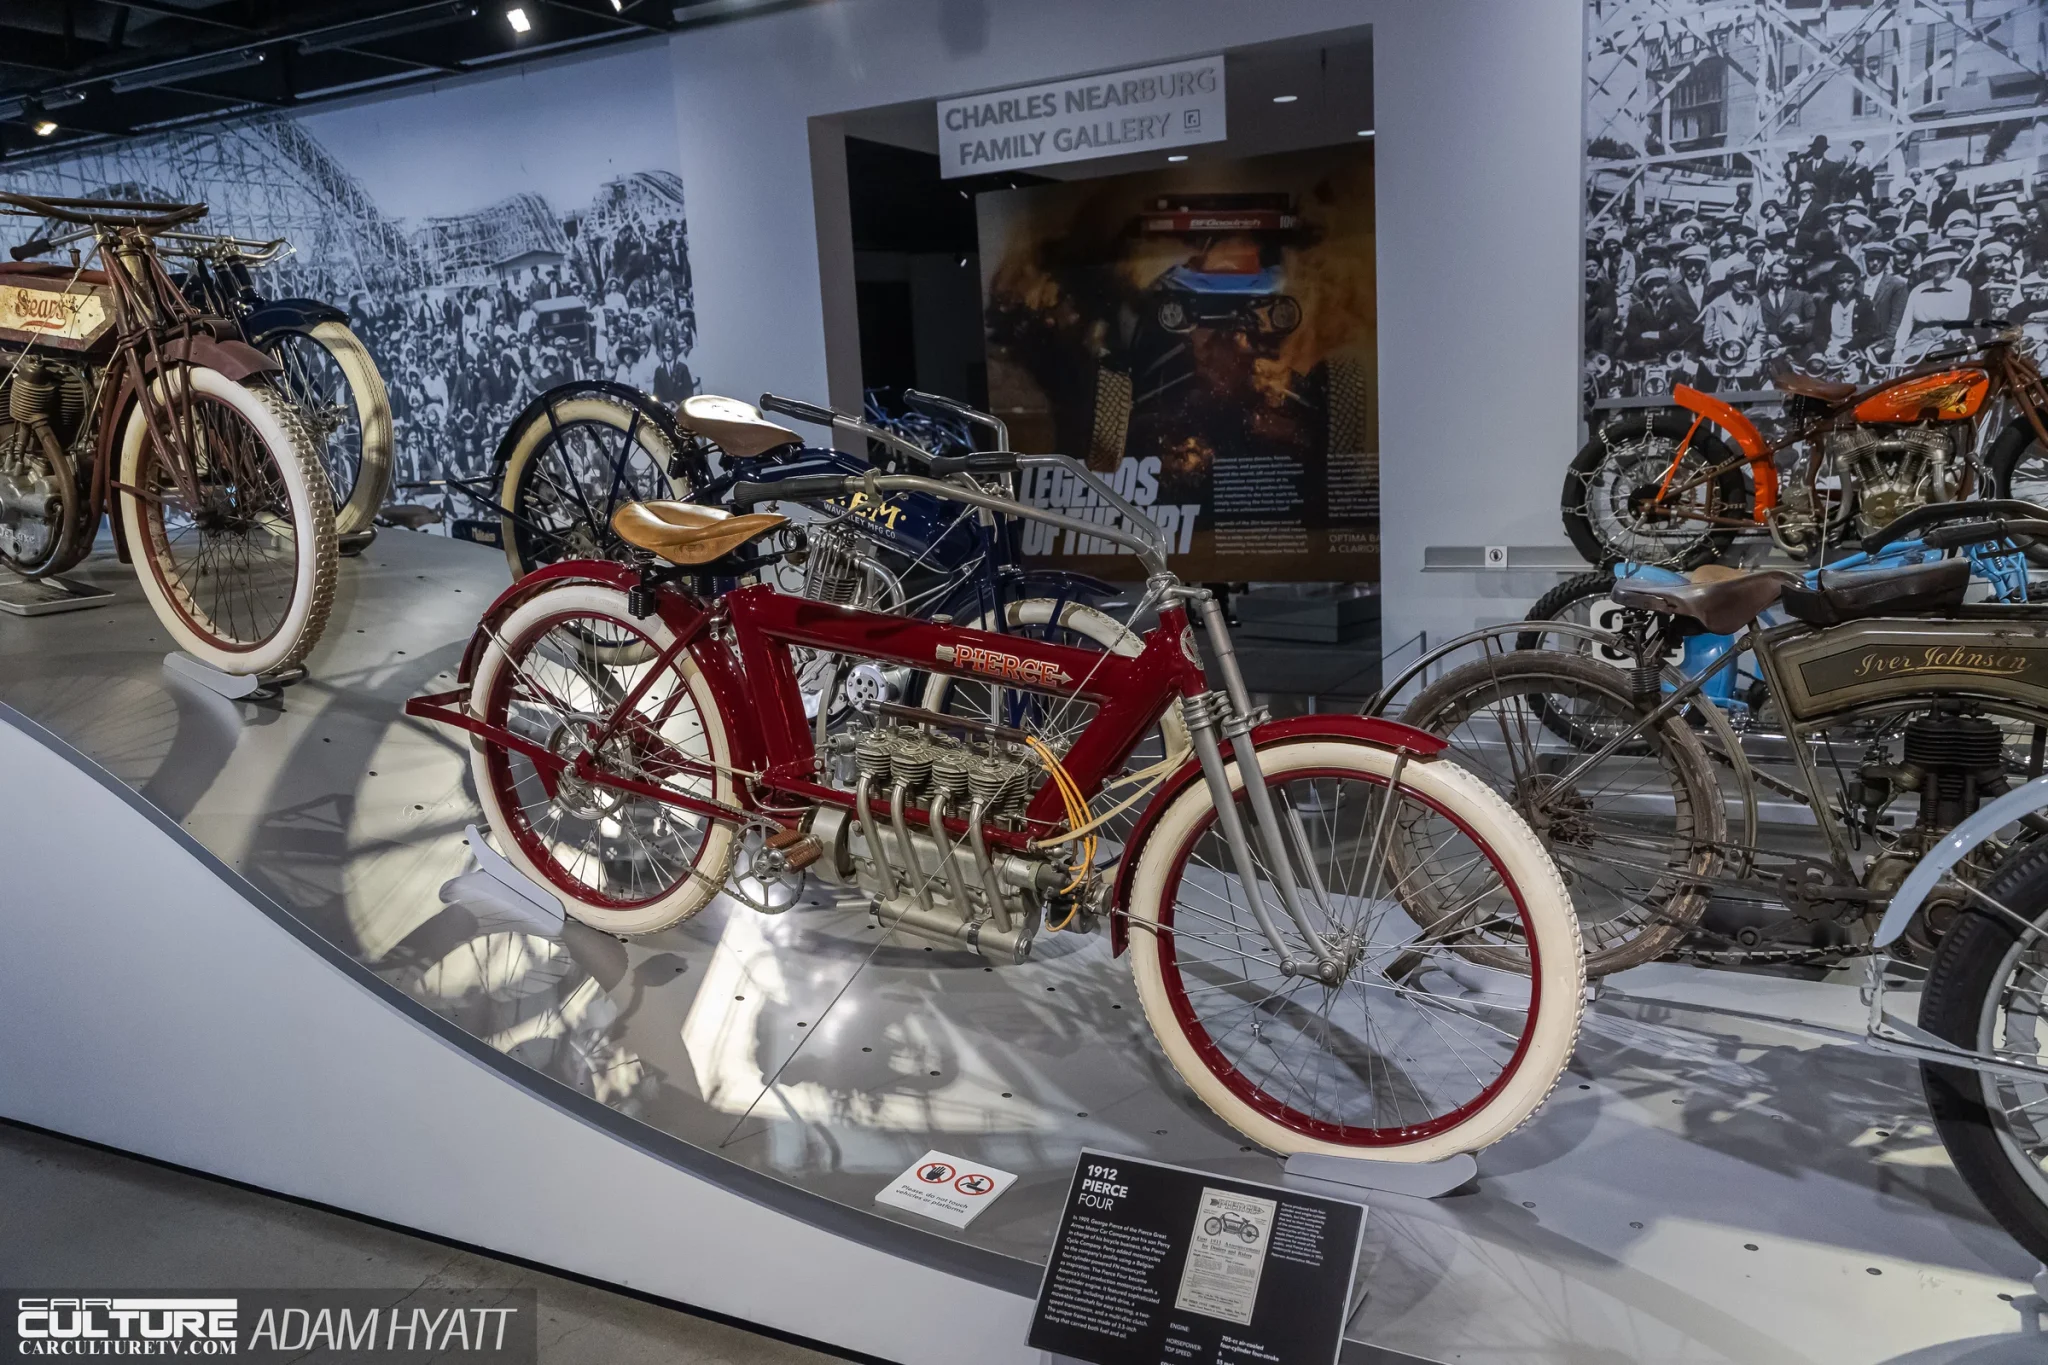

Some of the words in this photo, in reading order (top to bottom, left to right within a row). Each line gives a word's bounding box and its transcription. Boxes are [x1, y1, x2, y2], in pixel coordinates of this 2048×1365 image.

[945, 93, 1057, 132] CHARLES
[1065, 67, 1217, 114] NEARBURG
[959, 131, 1046, 166] FAMILY
[1053, 112, 1171, 152] GALLERY
[15, 288, 67, 320] Sears
[867, 521, 885, 535] MFG
[1329, 533, 1367, 543] OPTIMA
[1329, 545, 1337, 553] A
[954, 644, 1060, 687] PIERCE
[1854, 653, 1912, 676] Iver
[1918, 644, 2032, 674] Johnson
[1087, 1164, 1118, 1181] 1912
[1081, 1178, 1129, 1199] PIERCE
[896, 1189, 922, 1200] vehicles
[931, 1201, 964, 1213] platforms
[949, 1199, 968, 1210] touch
[1077, 1193, 1114, 1212] FOUR
